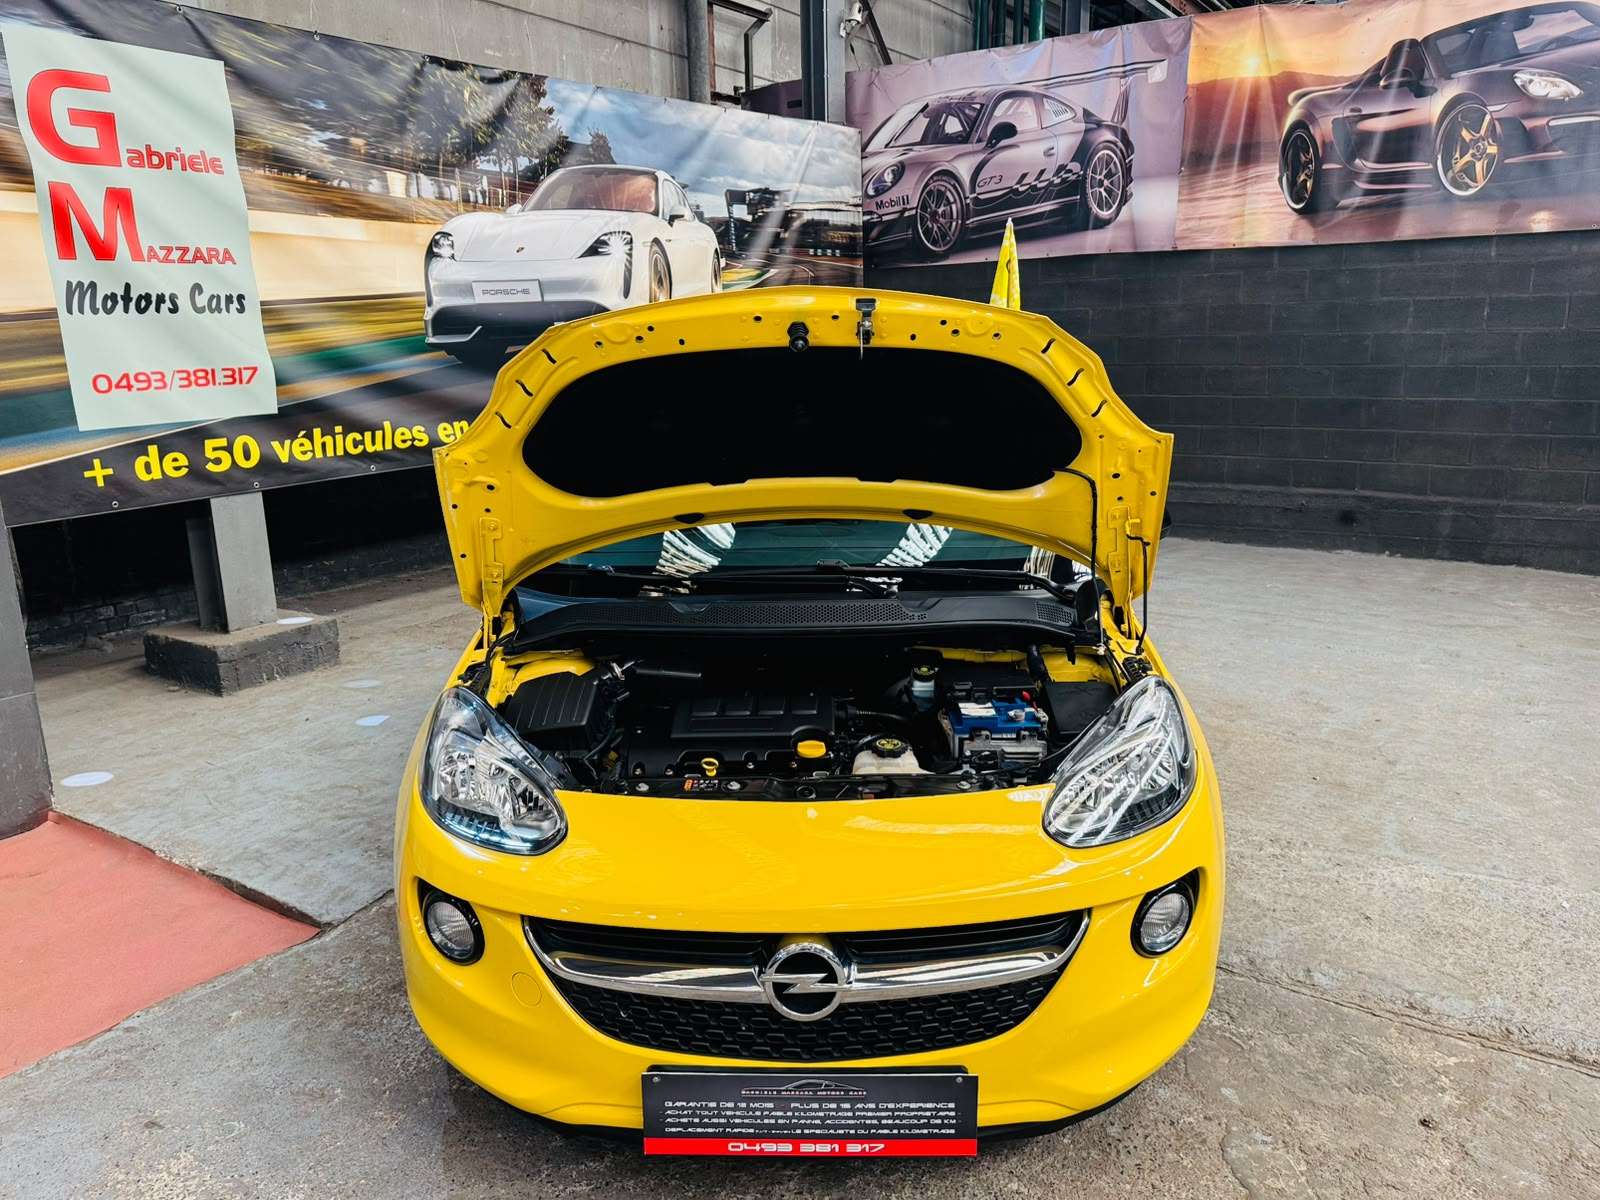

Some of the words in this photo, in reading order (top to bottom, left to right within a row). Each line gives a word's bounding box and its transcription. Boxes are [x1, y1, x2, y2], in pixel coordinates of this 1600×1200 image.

[977, 175, 1003, 188] GT3
[65, 280, 180, 316] Motors
[189, 282, 246, 315] Cars
[481, 288, 530, 296] PORSCHE
[92, 366, 259, 395] 0493/381.317
[134, 444, 190, 482] de
[204, 435, 260, 473] 50
[272, 420, 430, 464] véhicules
[728, 1143, 793, 1152] 0493
[800, 1143, 840, 1153] 381
[846, 1143, 886, 1153] 317
